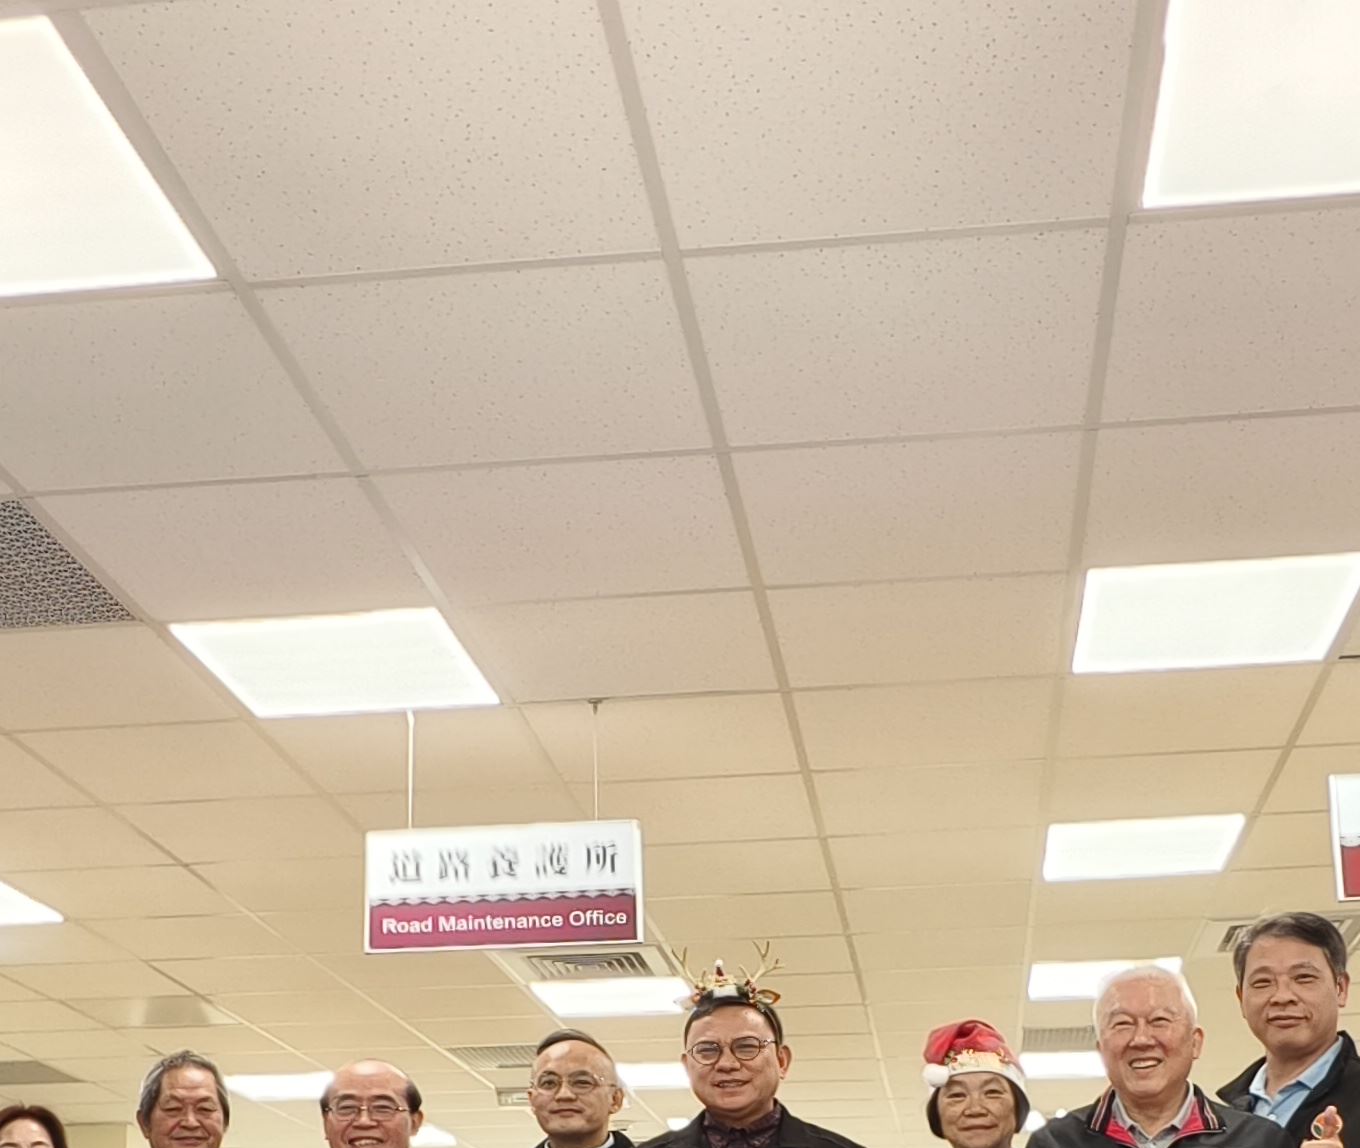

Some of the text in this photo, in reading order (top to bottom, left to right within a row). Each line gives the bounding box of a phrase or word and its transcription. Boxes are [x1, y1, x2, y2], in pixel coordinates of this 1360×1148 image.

[389, 840, 618, 886] 道路養護所
[382, 908, 628, 935] Road Maintenance Office
